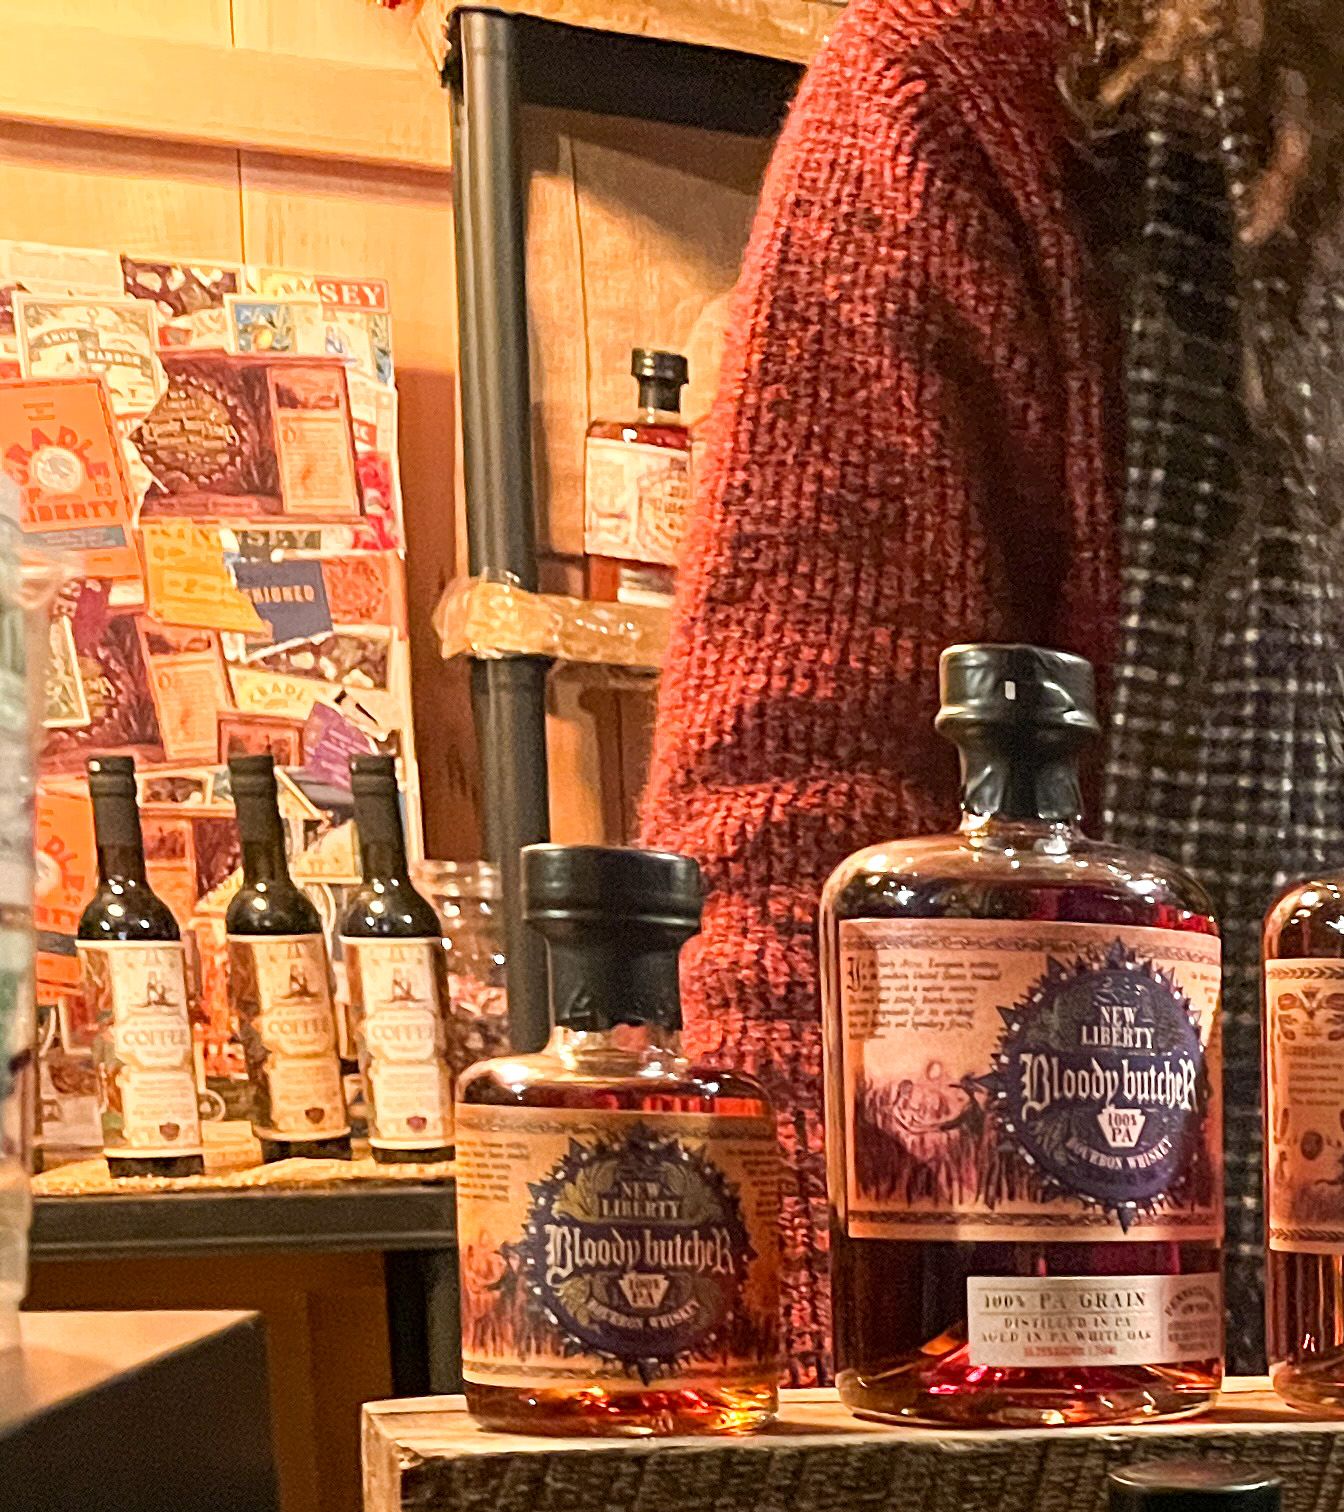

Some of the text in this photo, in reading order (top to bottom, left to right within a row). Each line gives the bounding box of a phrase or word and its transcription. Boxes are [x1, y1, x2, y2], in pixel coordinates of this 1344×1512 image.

[22, 499, 119, 524] IBERTY
[1100, 1006, 1138, 1026] NEW
[1080, 1025, 1155, 1050] LIBERTY
[1018, 1052, 1118, 1122] Bloody
[1111, 1127, 1133, 1144] PA
[1126, 1137, 1174, 1170] WHISKEY
[543, 1223, 640, 1296] Bloody
[1079, 1291, 1147, 1309] GRAIN
